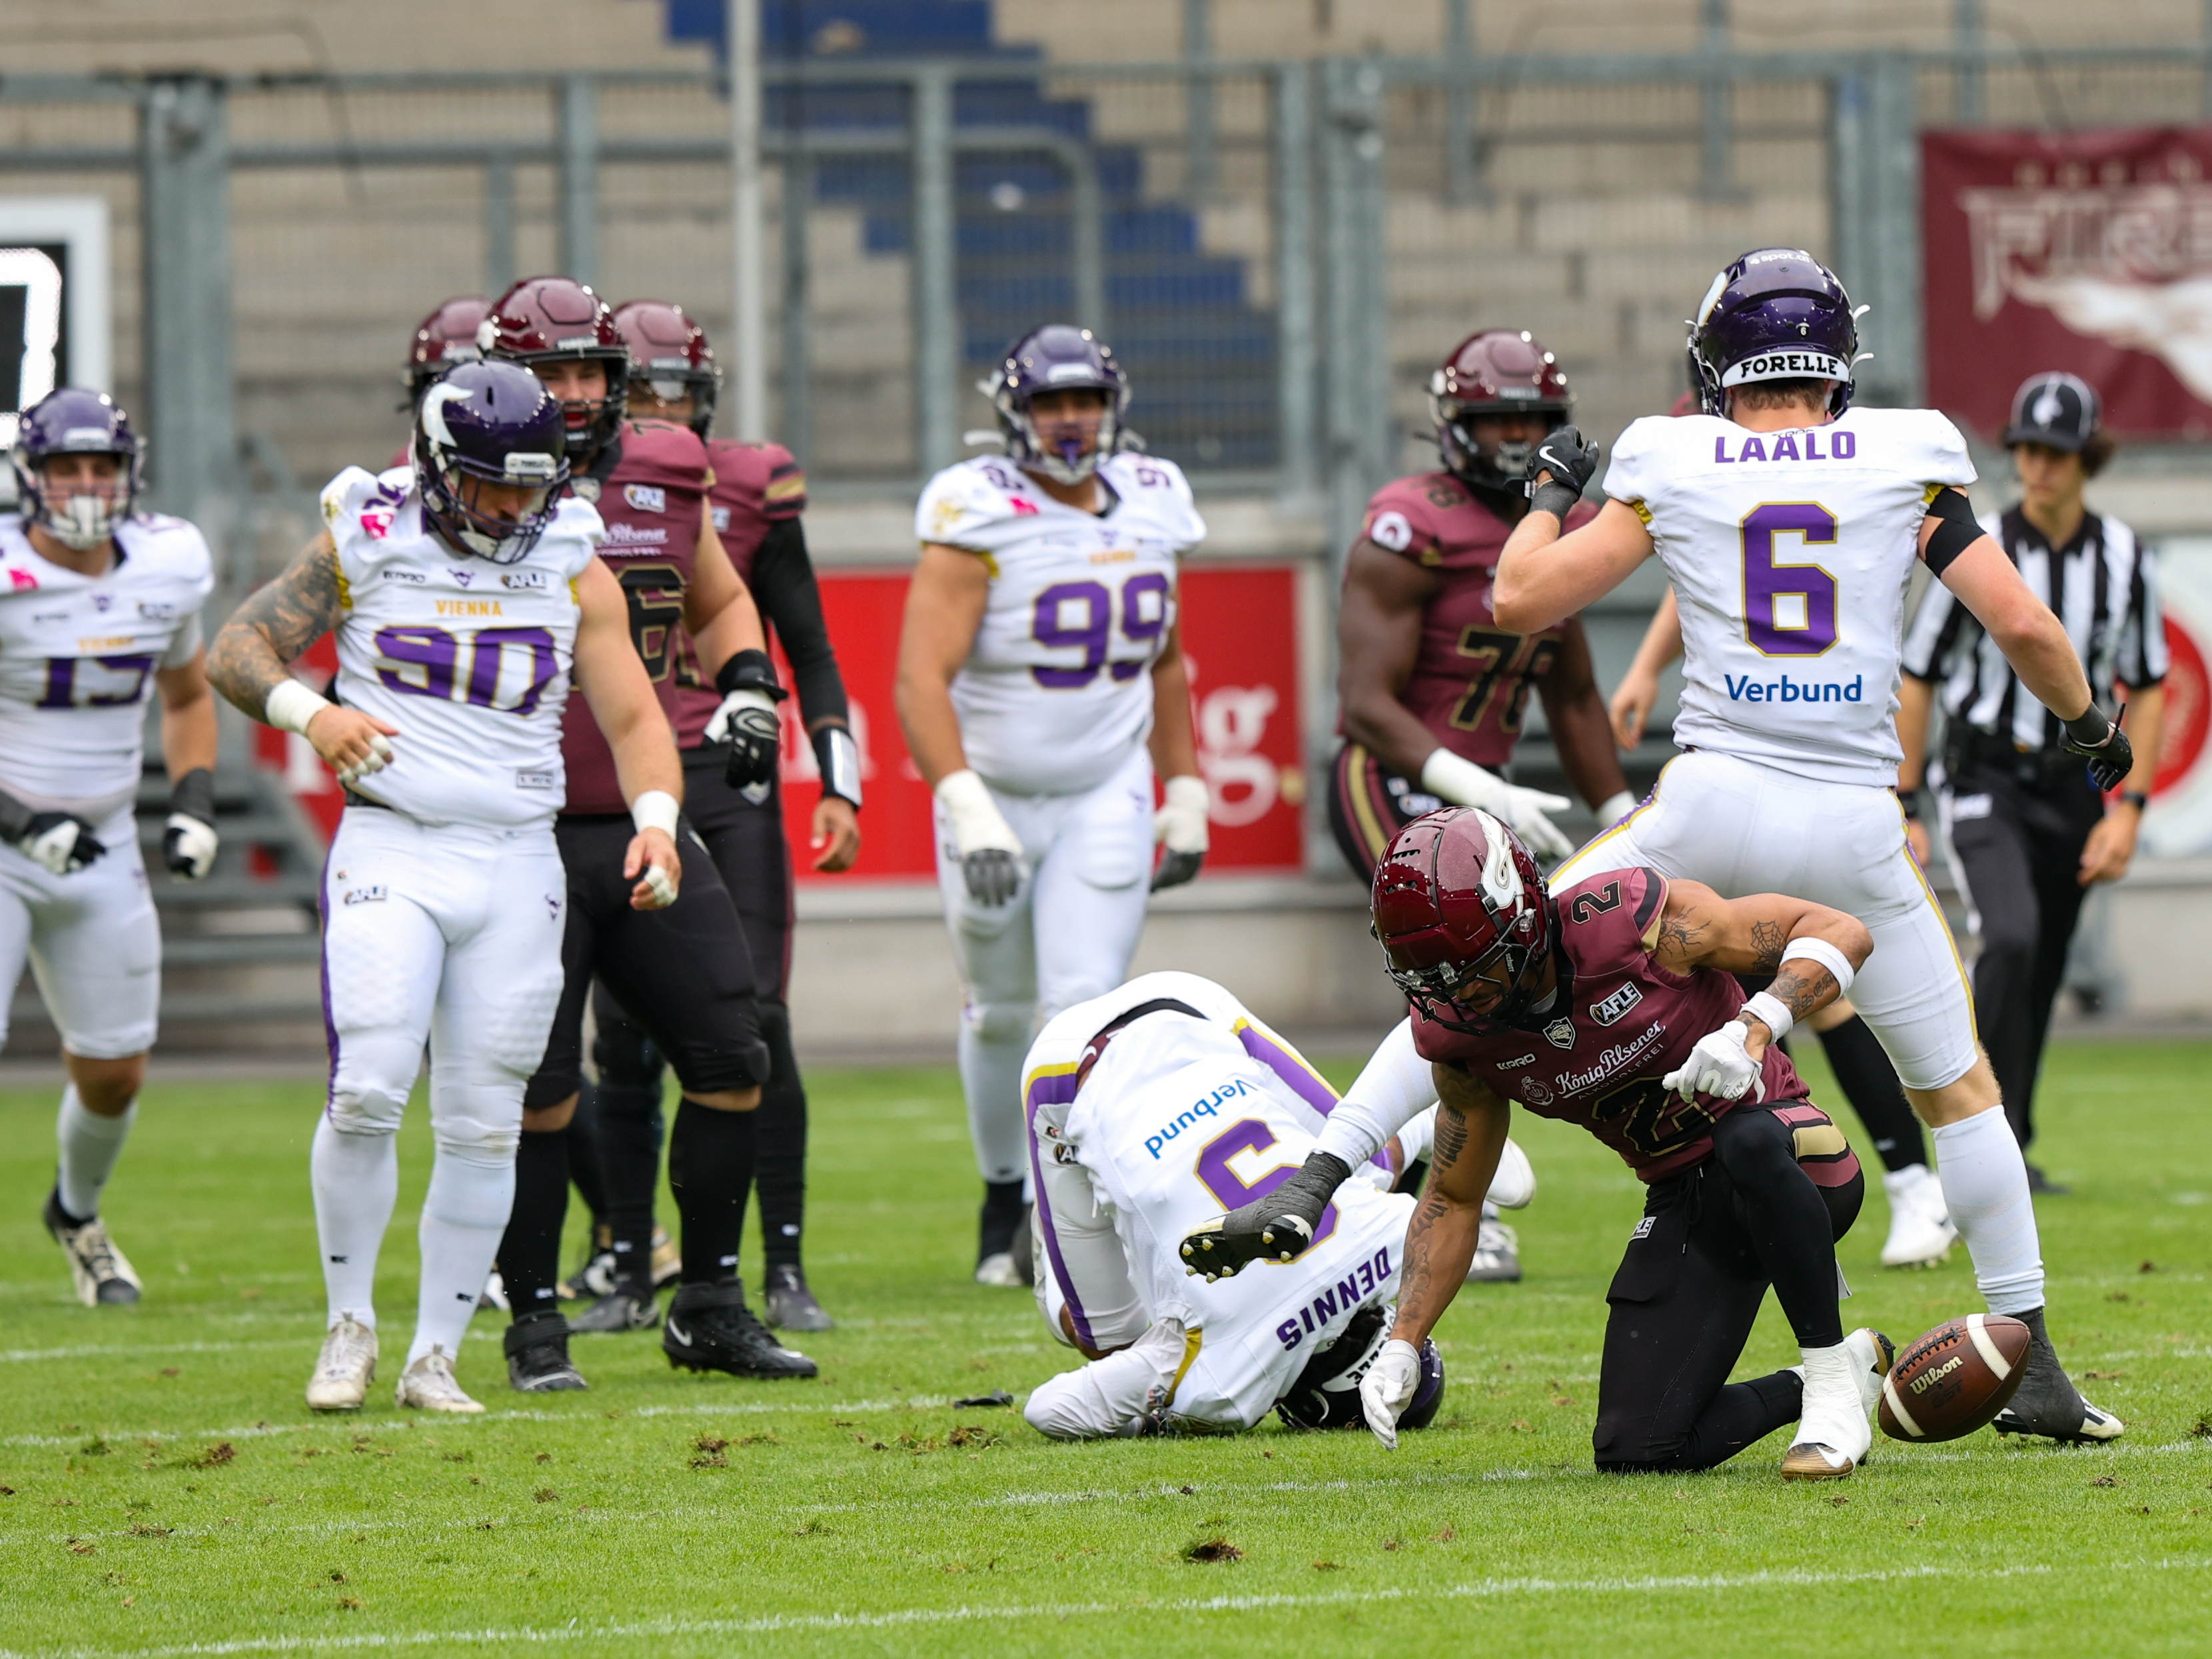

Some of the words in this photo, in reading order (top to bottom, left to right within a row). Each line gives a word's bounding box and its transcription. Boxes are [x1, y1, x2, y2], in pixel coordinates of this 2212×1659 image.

[1800, 326, 1807, 336] 6
[1740, 355, 1838, 378] FORELLE
[1715, 432, 1856, 463] LAALO
[1740, 501, 1841, 657] 6
[436, 600, 503, 616] VIENNA
[1031, 572, 1169, 689] 99
[374, 625, 560, 718] 90
[1724, 674, 1862, 702] Verbund
[1571, 879, 1622, 925] 2
[1600, 985, 1638, 1021] AFLE
[1556, 1065, 1606, 1095] König
[1599, 1020, 1665, 1072] Pilsener
[1578, 1043, 1664, 1100] ALKOHOLFREI
[1144, 1079, 1259, 1159] Verbund
[1277, 1246, 1392, 1351] DENNIS
[1910, 1356, 1963, 1394] Wilson
